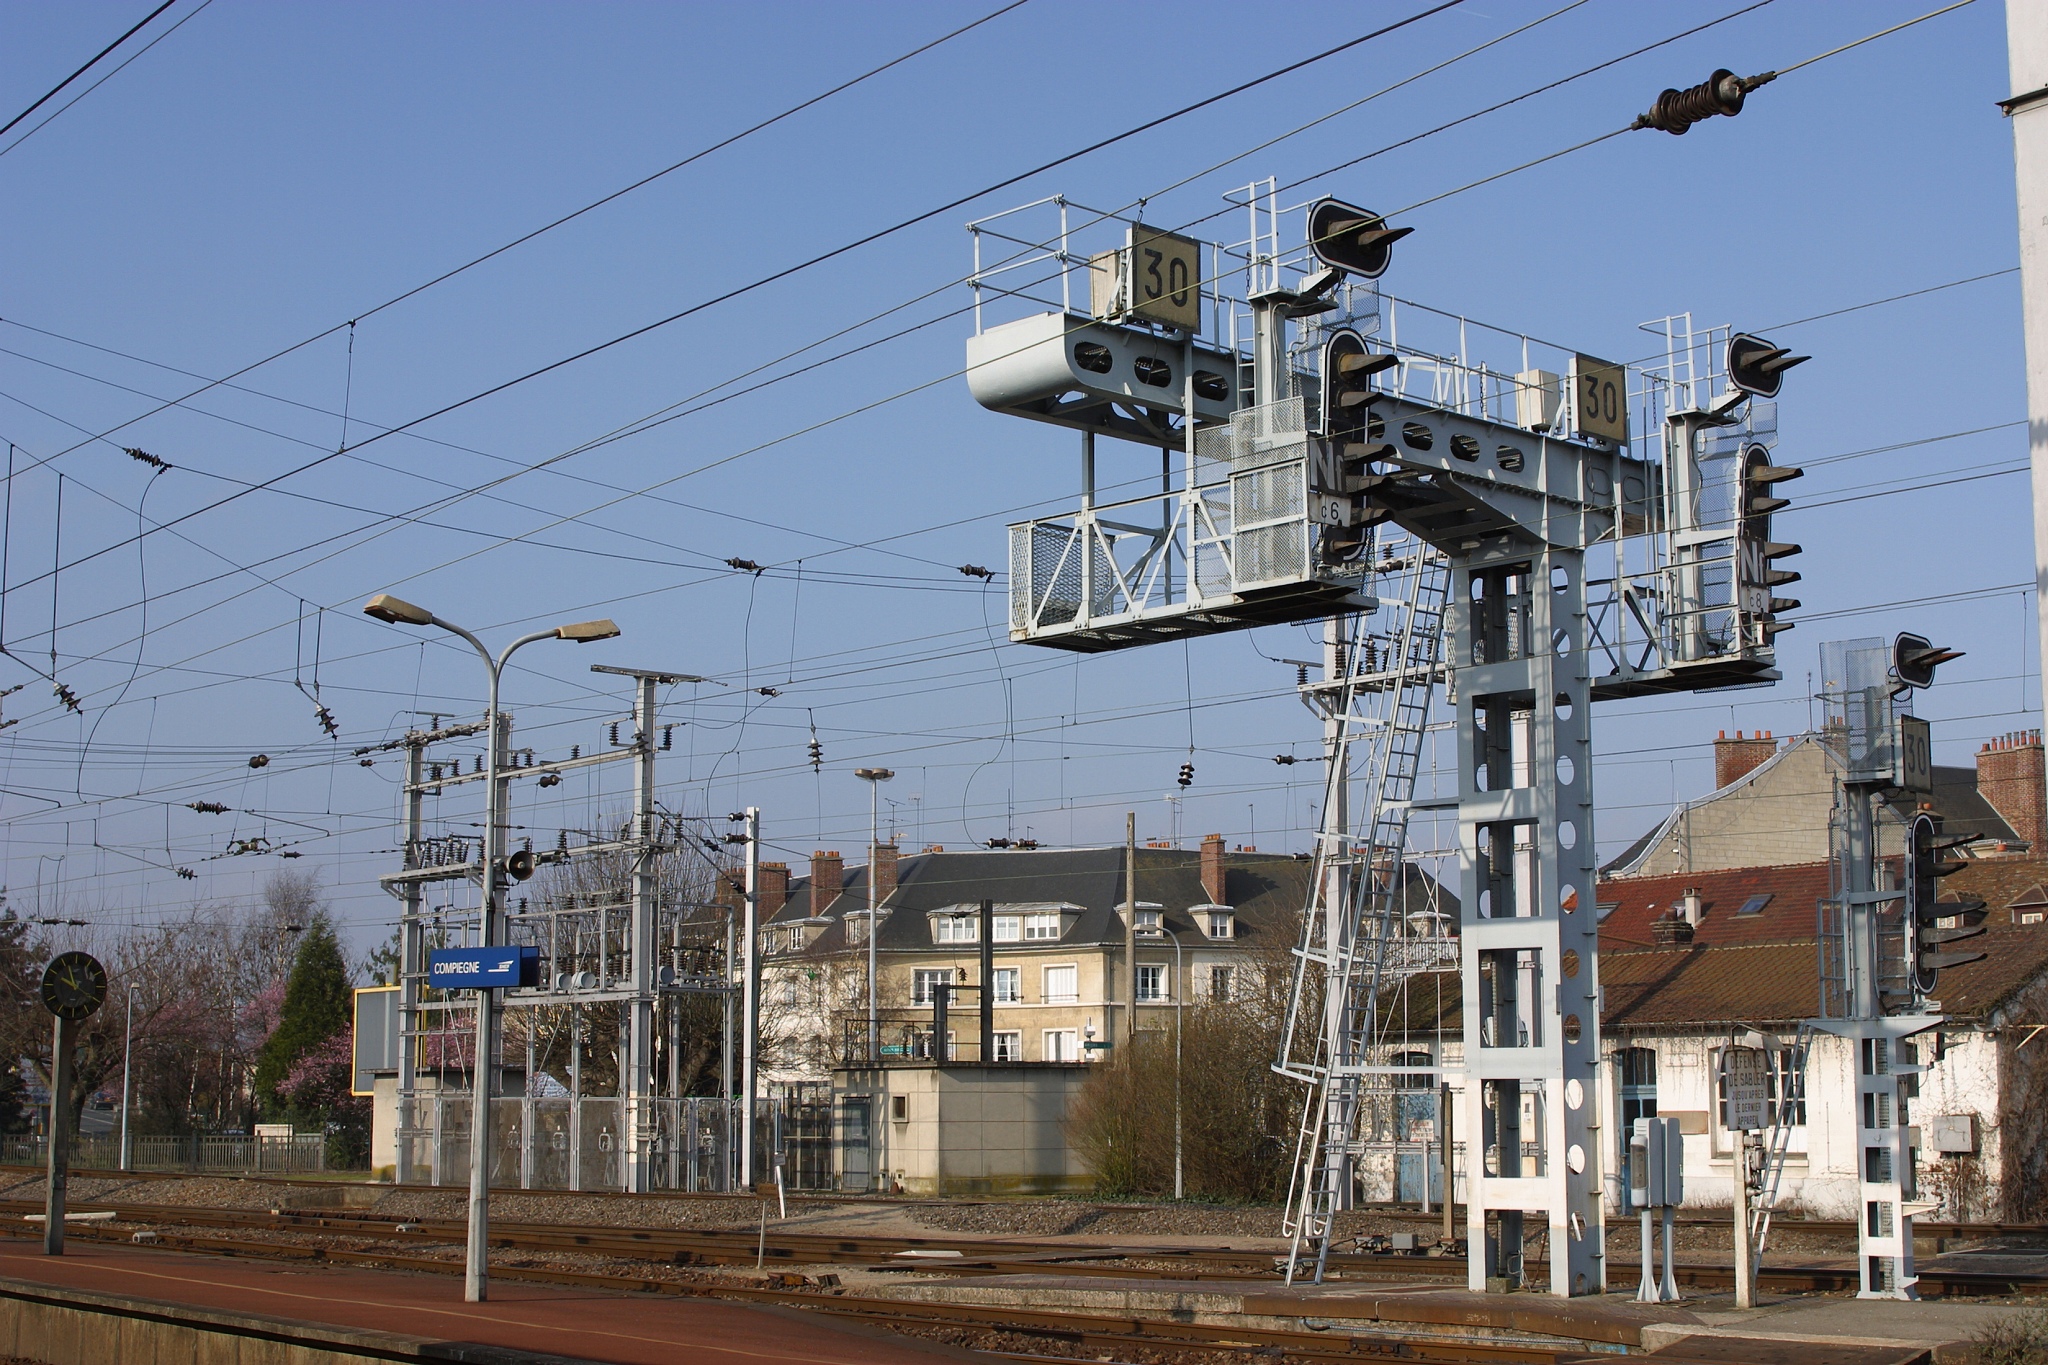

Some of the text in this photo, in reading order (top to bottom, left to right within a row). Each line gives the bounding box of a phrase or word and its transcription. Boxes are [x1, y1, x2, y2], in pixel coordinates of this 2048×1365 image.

[1145, 248, 1188, 307] 30
[1585, 375, 1617, 424] 30
[1309, 436, 1343, 492] Nf
[1741, 540, 1765, 584] Nf
[1907, 734, 1926, 776] 30
[434, 962, 480, 974] COMPIEGNE
[1728, 1072, 1765, 1087] DE SABLER
[1730, 1054, 1761, 1070] DEFENSE
